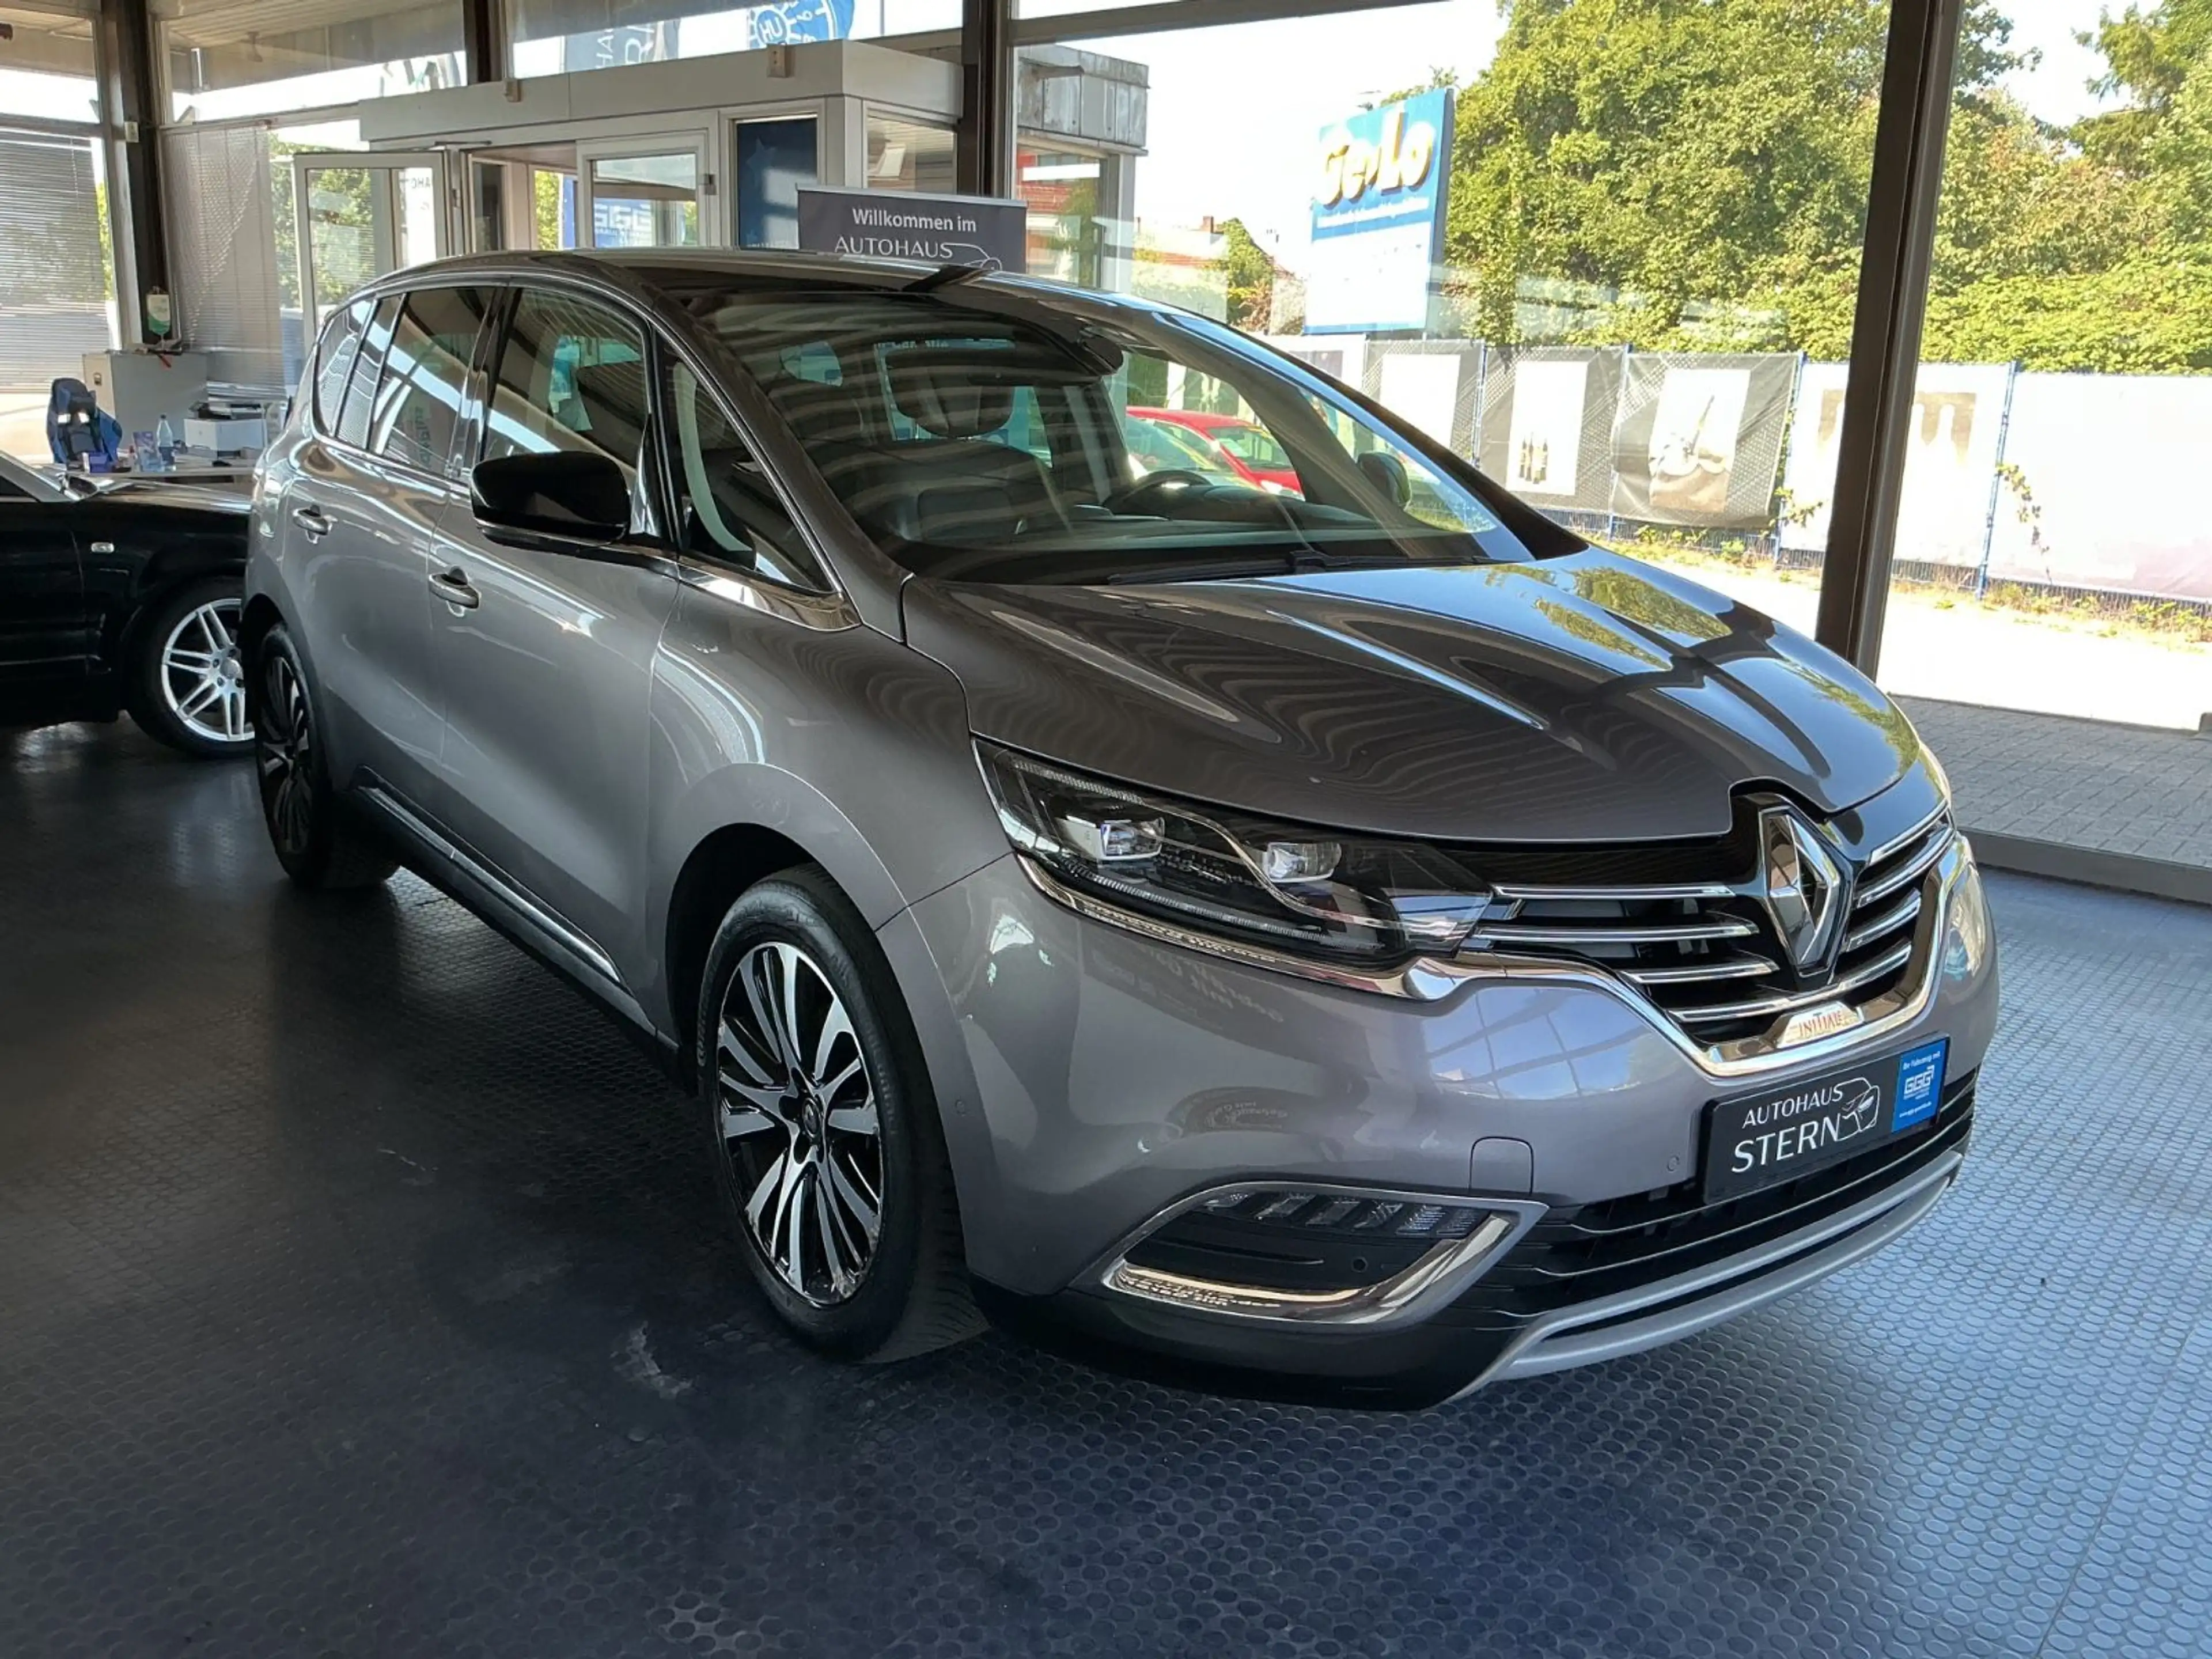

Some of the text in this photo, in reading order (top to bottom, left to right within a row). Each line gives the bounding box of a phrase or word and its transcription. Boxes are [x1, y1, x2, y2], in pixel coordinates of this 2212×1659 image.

[759, 17, 783, 43] HU
[852, 208, 977, 233] Willkommen im
[834, 236, 953, 259] AUTOHAUS
[1741, 1084, 1843, 1129] AUTOHAUS
[1731, 1112, 1842, 1173] STERN
